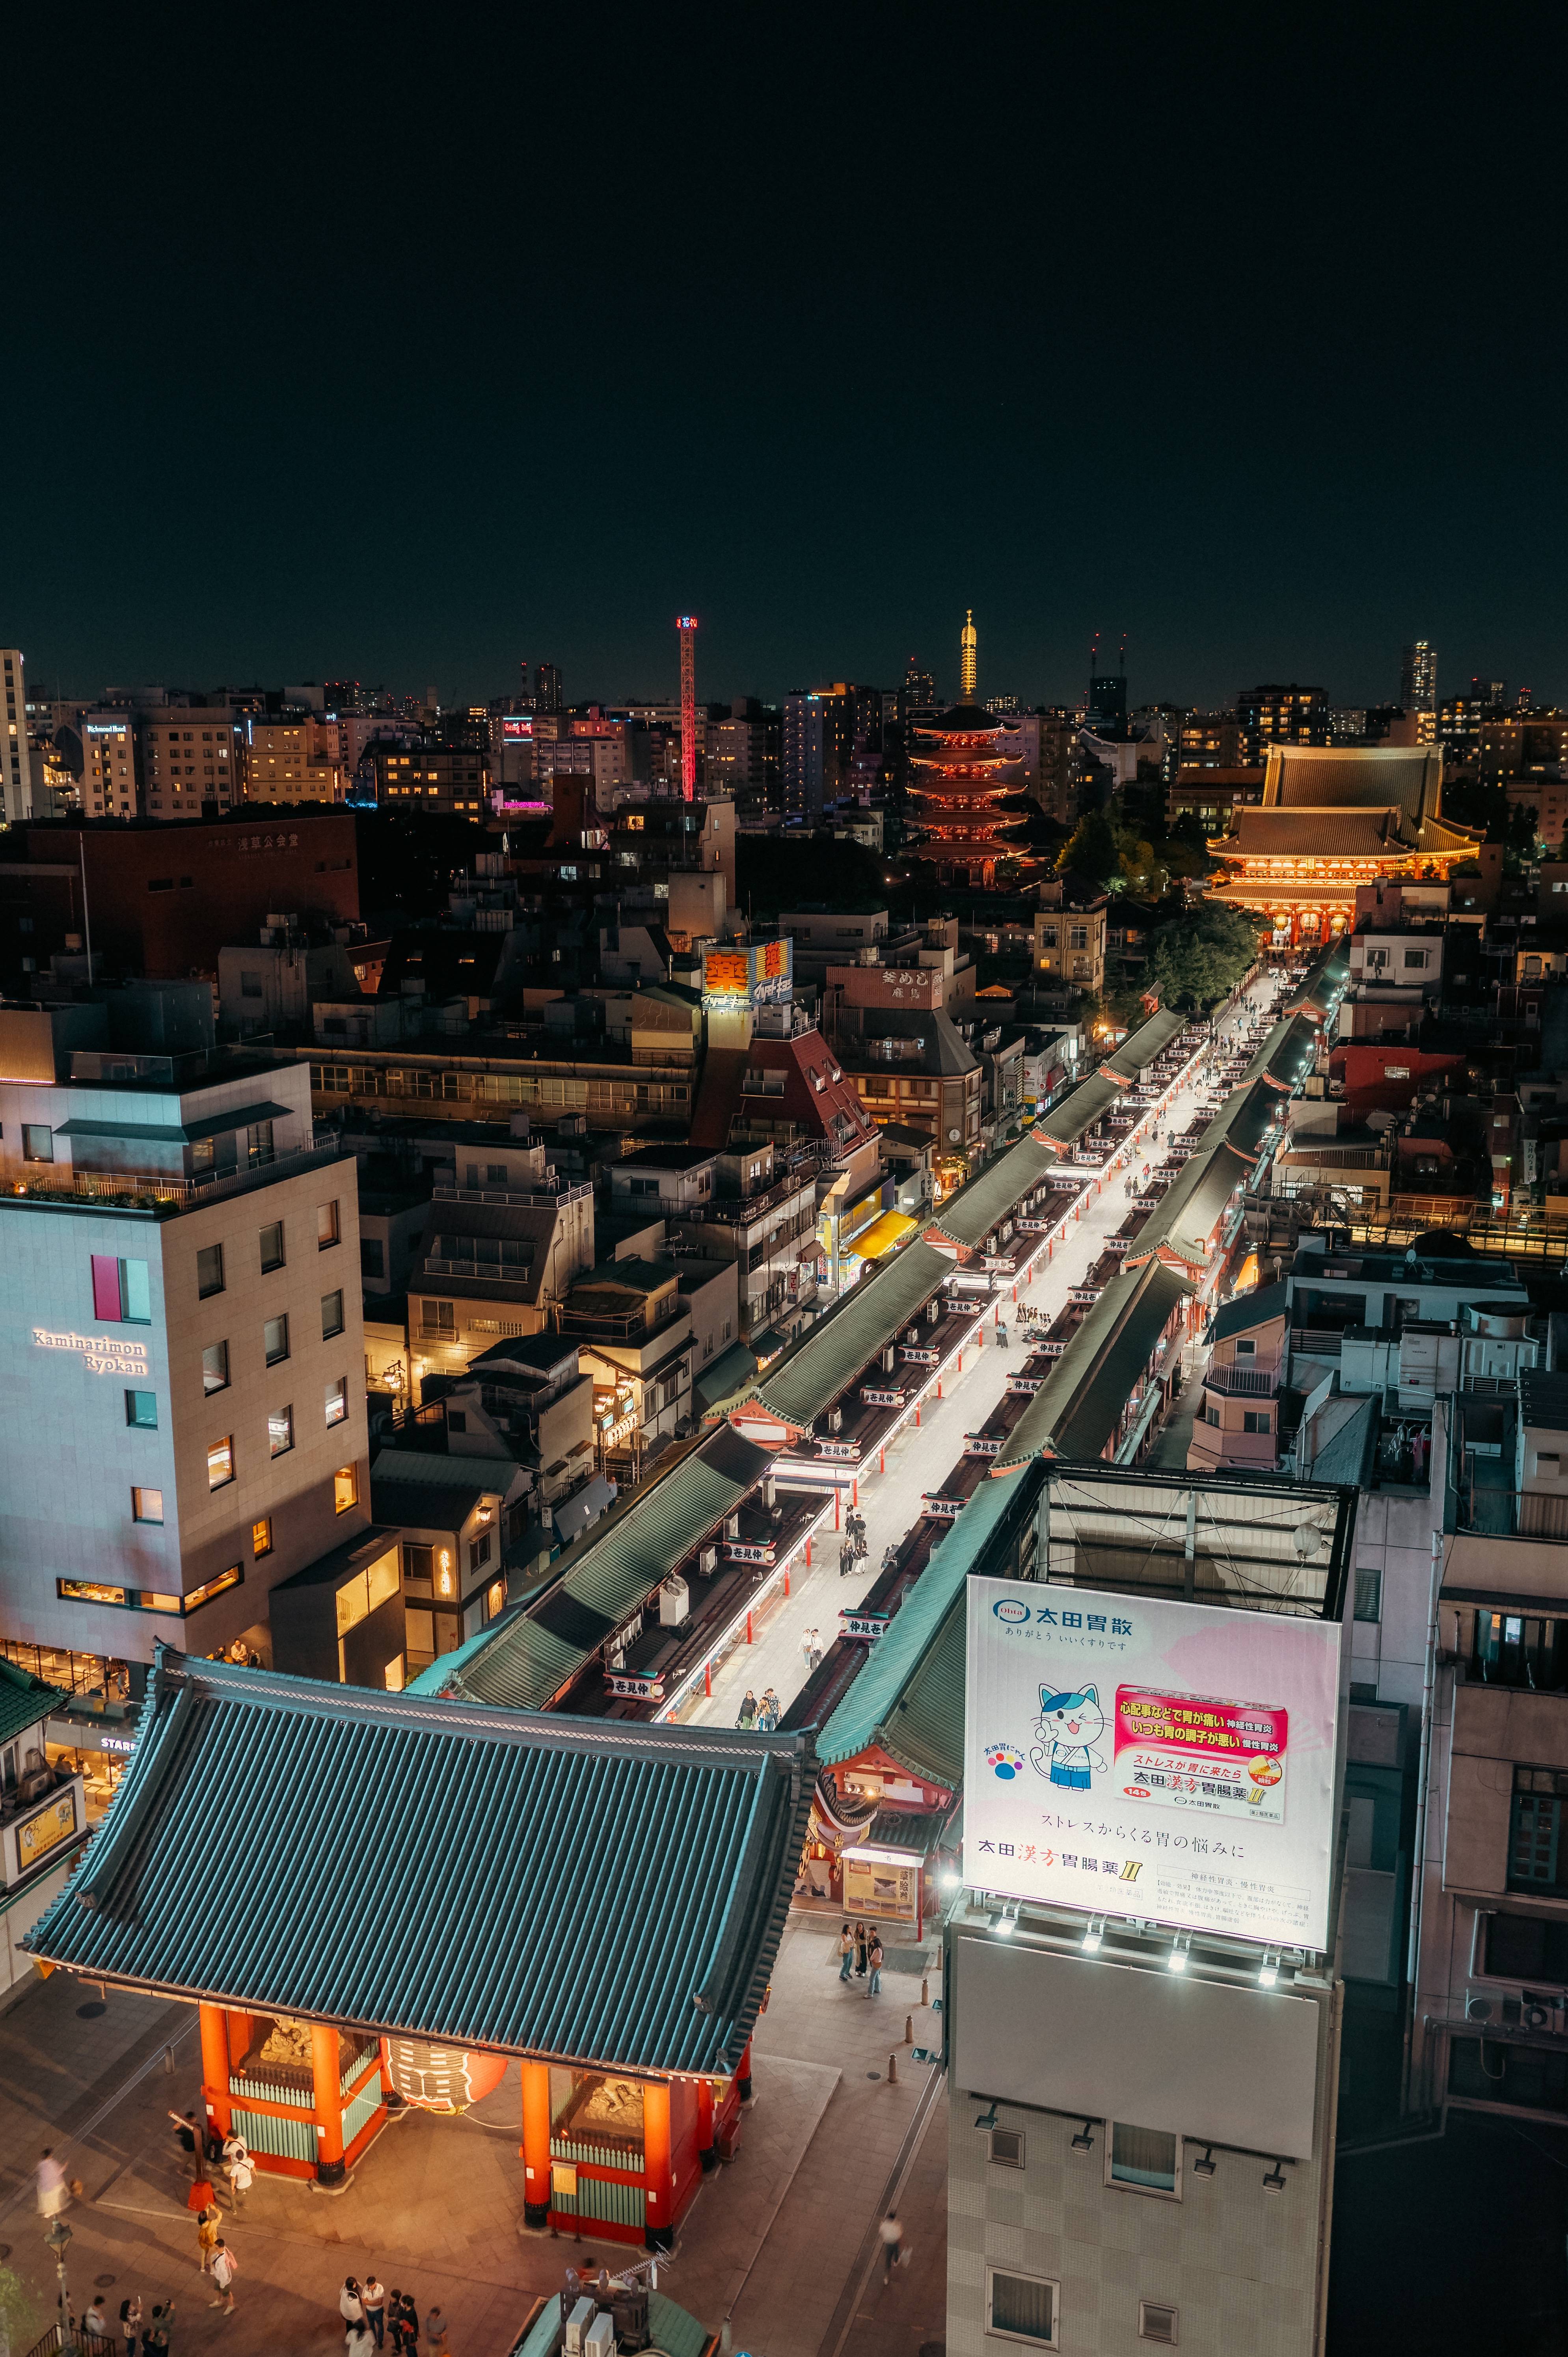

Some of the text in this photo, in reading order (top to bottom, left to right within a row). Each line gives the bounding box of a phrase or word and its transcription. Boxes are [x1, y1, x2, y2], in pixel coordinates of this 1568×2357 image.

[505, 724, 519, 734] Sting
[238, 833, 298, 851] 浅草公会堂
[765, 941, 780, 978] 薬
[706, 954, 747, 991] 薬
[882, 971, 928, 985] 釜めし
[701, 994, 752, 1008] マツモトキヨシ
[1007, 1089, 1015, 1109] 梅園
[33, 1332, 143, 1355] Kaminarimon
[83, 1355, 144, 1374] Ryokan
[1037, 1608, 1132, 1636] 太田胃散
[1006, 1627, 1126, 1651] ありがとう いいくすりです
[1120, 1701, 1225, 1727] 心配事などで胃が痛い
[1227, 1719, 1272, 1734] 神経性胃炎
[1132, 1721, 1279, 1752] いつも胃の調子が悪い 慢性胃炎
[984, 1743, 1026, 1761] 太田胃にゃん
[1128, 1788, 1147, 1797] 14包
[1189, 1800, 1220, 1810] 太田胃散
[1042, 1815, 1244, 1858] ストレスからくる胃の悩みに
[1192, 1872, 1274, 1893] 神経性胃炎・慢性胃炎
